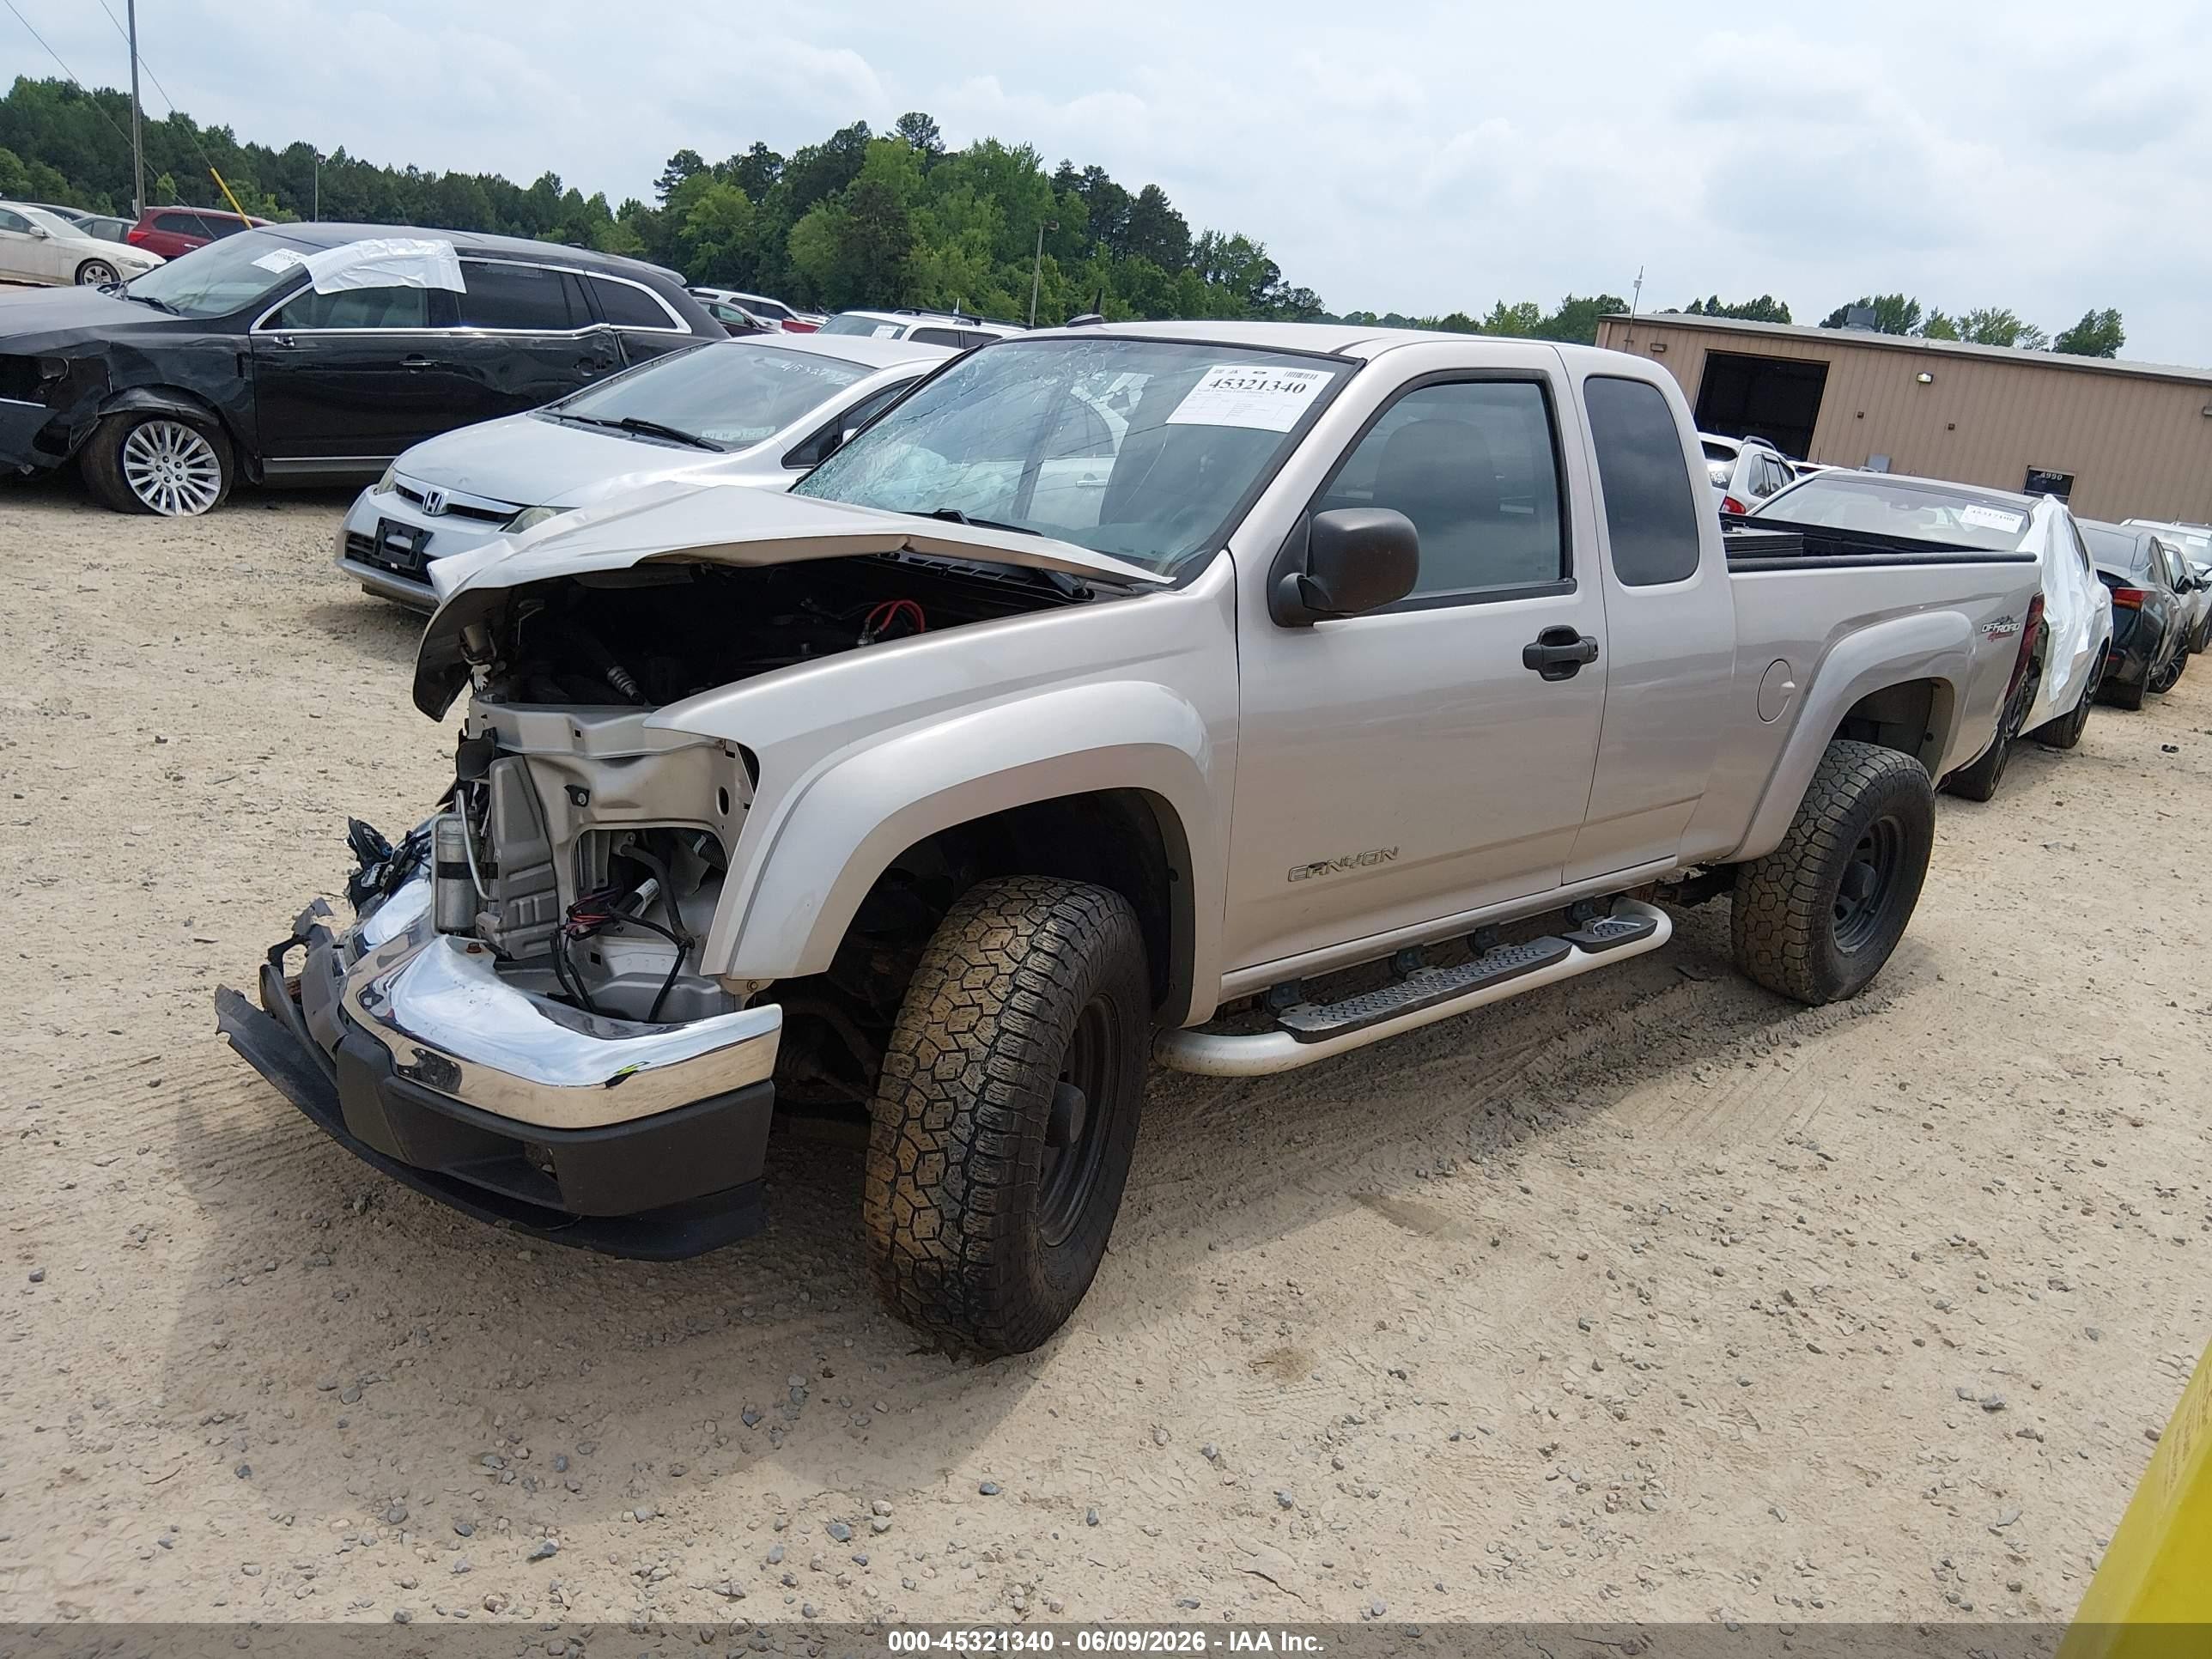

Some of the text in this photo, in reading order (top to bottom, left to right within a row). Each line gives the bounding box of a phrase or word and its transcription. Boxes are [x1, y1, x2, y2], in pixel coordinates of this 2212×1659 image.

[1209, 378, 1307, 394] 45321340
[2039, 471, 2063, 481] 4990
[1288, 846, 1399, 882] CANYON
